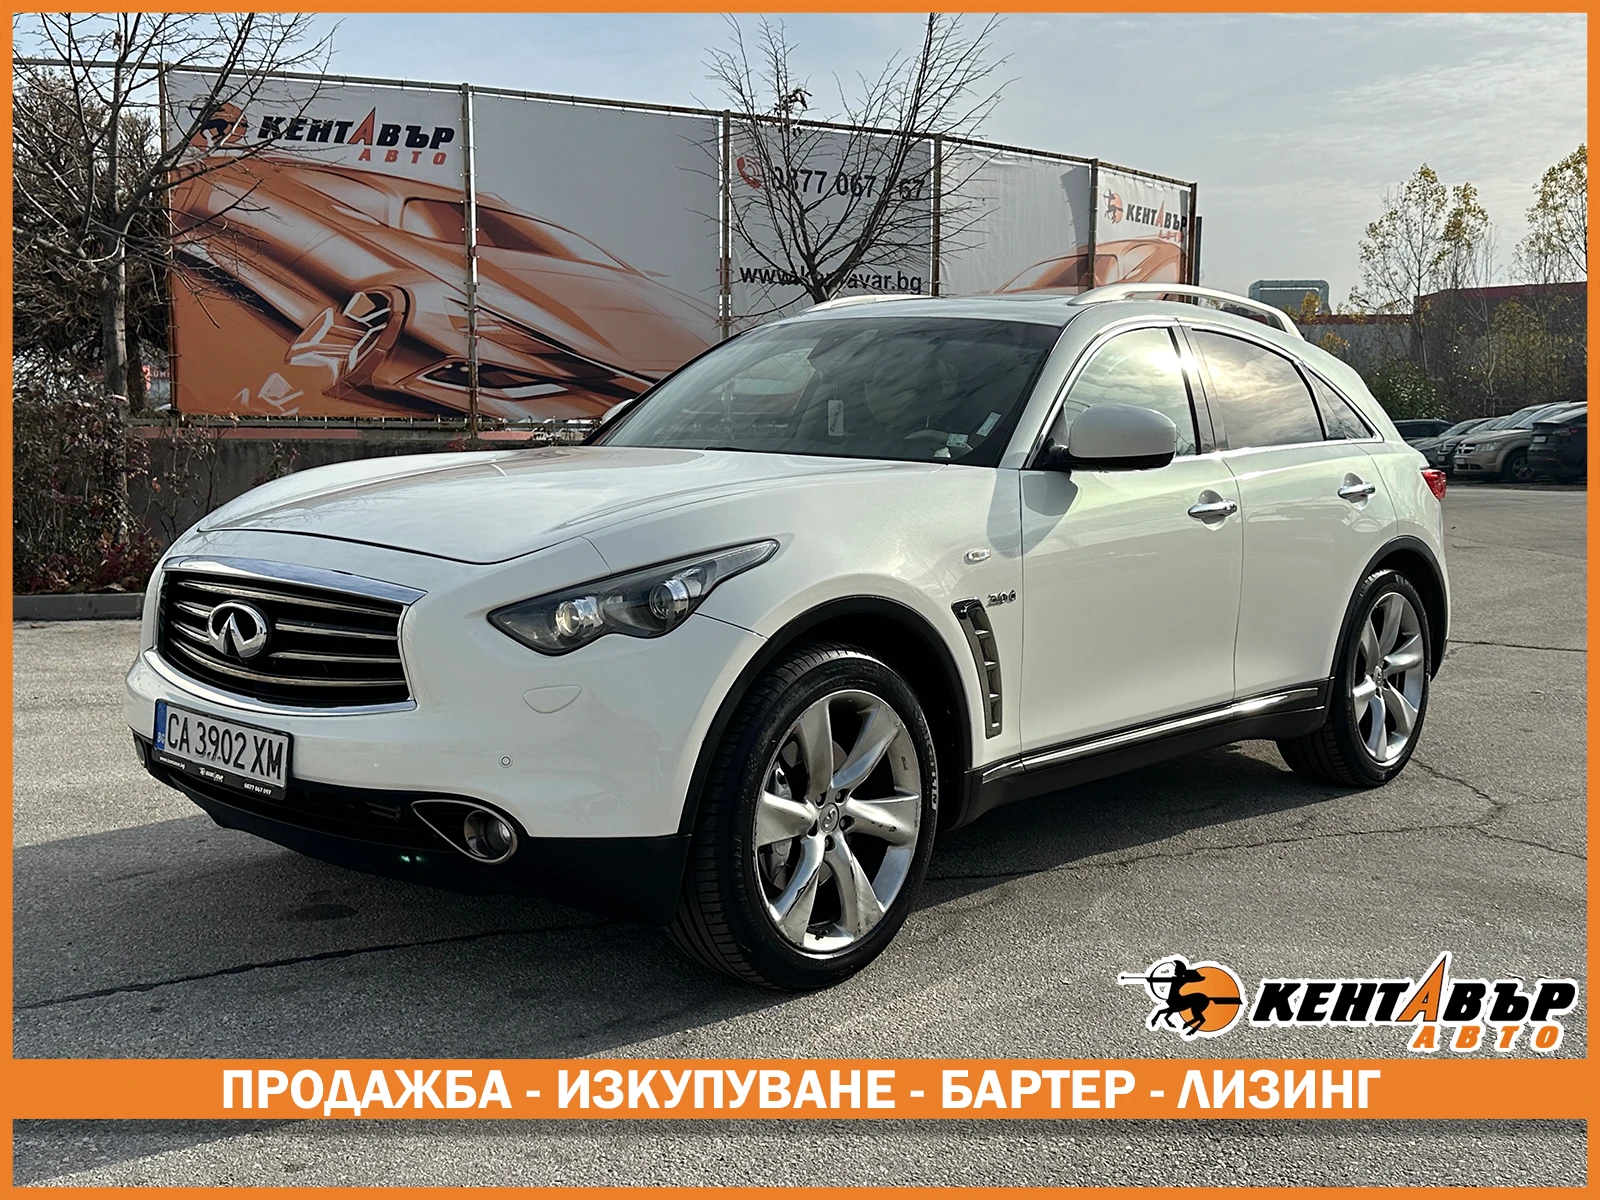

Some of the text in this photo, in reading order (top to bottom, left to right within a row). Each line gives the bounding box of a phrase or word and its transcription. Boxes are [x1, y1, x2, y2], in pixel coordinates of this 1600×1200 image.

[257, 106, 455, 149] КЕНТАВЪР
[358, 150, 447, 165] АВТО
[836, 172, 877, 198] 067
[1126, 200, 1187, 231] КЕНТАВЪР
[167, 713, 283, 780] CA 3902 XM
